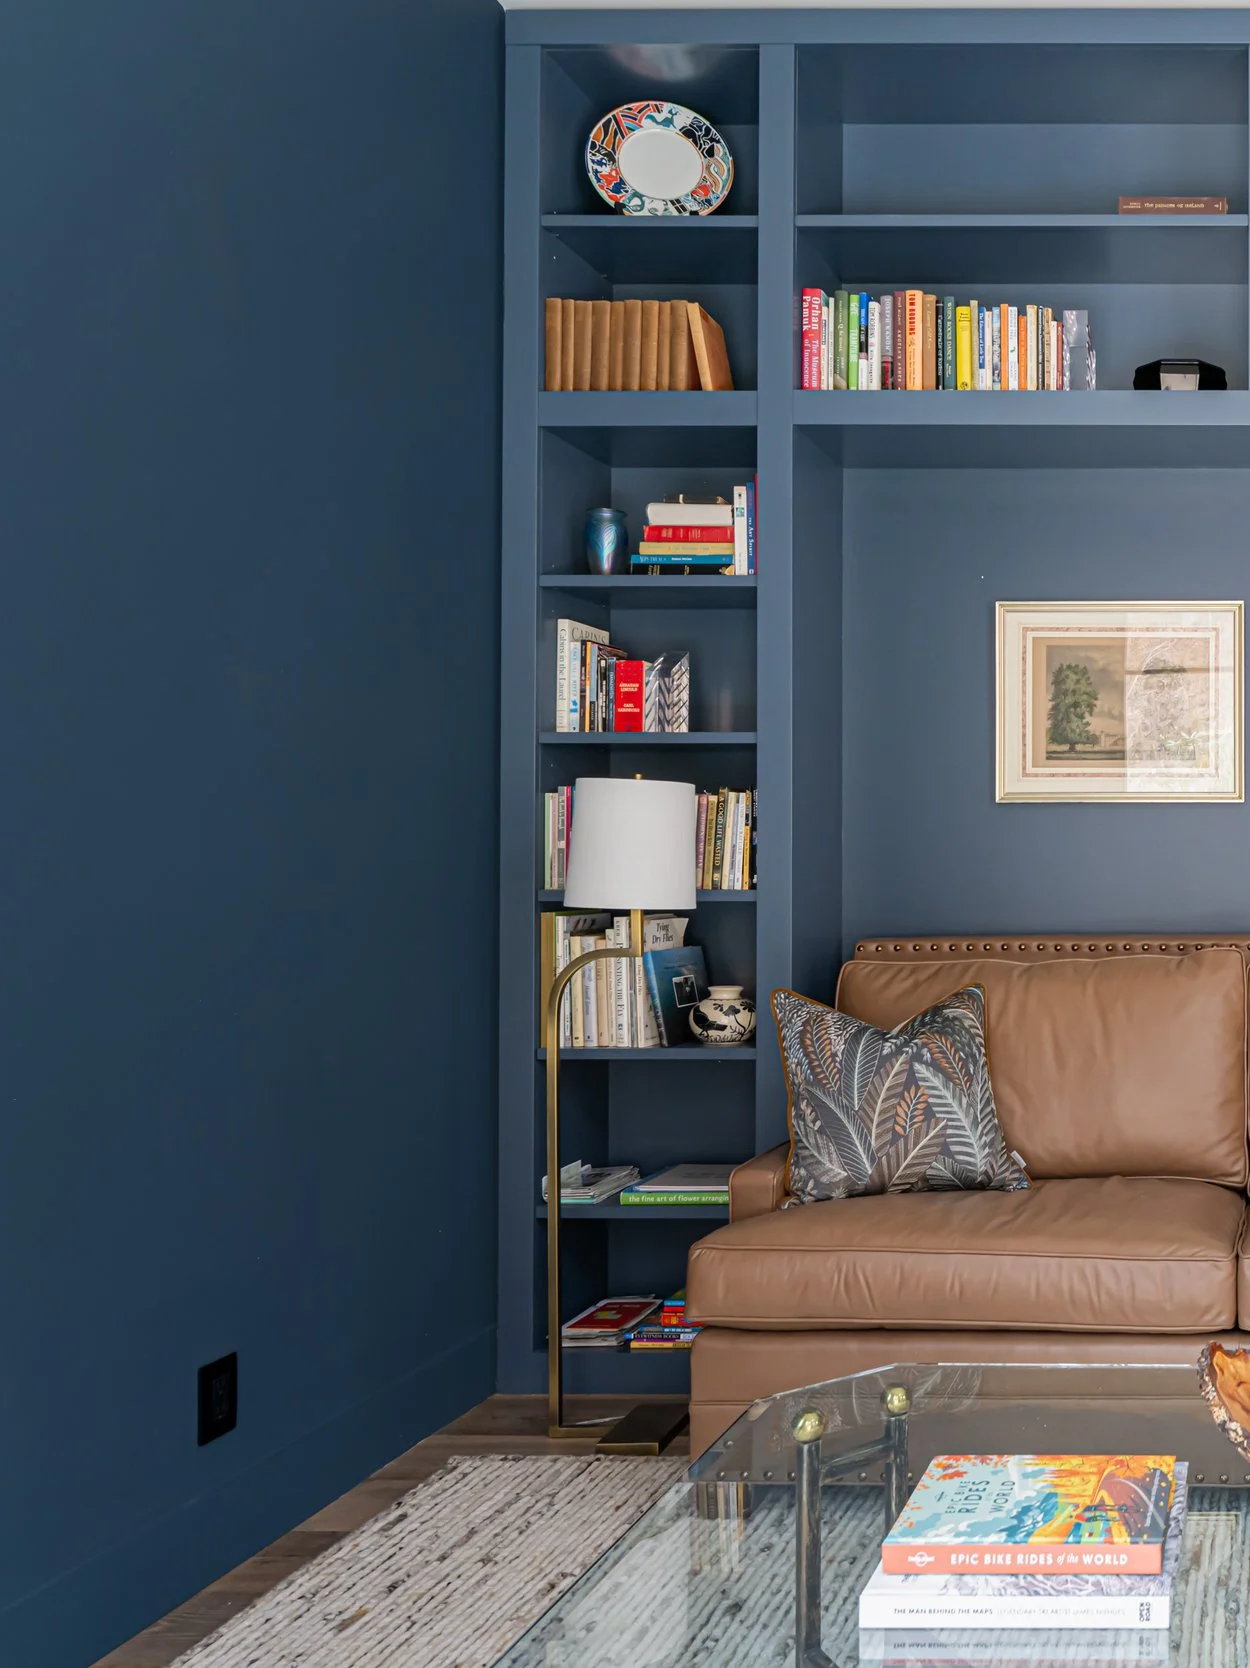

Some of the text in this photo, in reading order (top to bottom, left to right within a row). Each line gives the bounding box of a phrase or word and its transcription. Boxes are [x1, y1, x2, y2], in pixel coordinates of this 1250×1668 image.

[802, 295, 811, 331] Pamuk
[811, 296, 821, 330] Orhan
[908, 293, 916, 335] TOM ROBBINS
[803, 339, 811, 387] of Innocence
[811, 340, 820, 387] The Museum
[558, 628, 566, 654] Cabins
[558, 664, 566, 676] the
[558, 677, 566, 701] Laurel
[717, 802, 725, 823] GOOD
[714, 840, 722, 866] WASTED
[652, 933, 674, 944] Dry Flies
[656, 922, 670, 933] Tying
[616, 942, 624, 986] PSENTING
[616, 1004, 624, 1016] FLY
[677, 1194, 699, 1202] flower
[702, 1196, 729, 1204] arrangin
[945, 1499, 961, 1514] EPIC
[957, 1480, 990, 1514] RIDES
[989, 1480, 1015, 1514] WORLD
[950, 1552, 1128, 1566] EPIC BIKE RIDES of the WORLD
